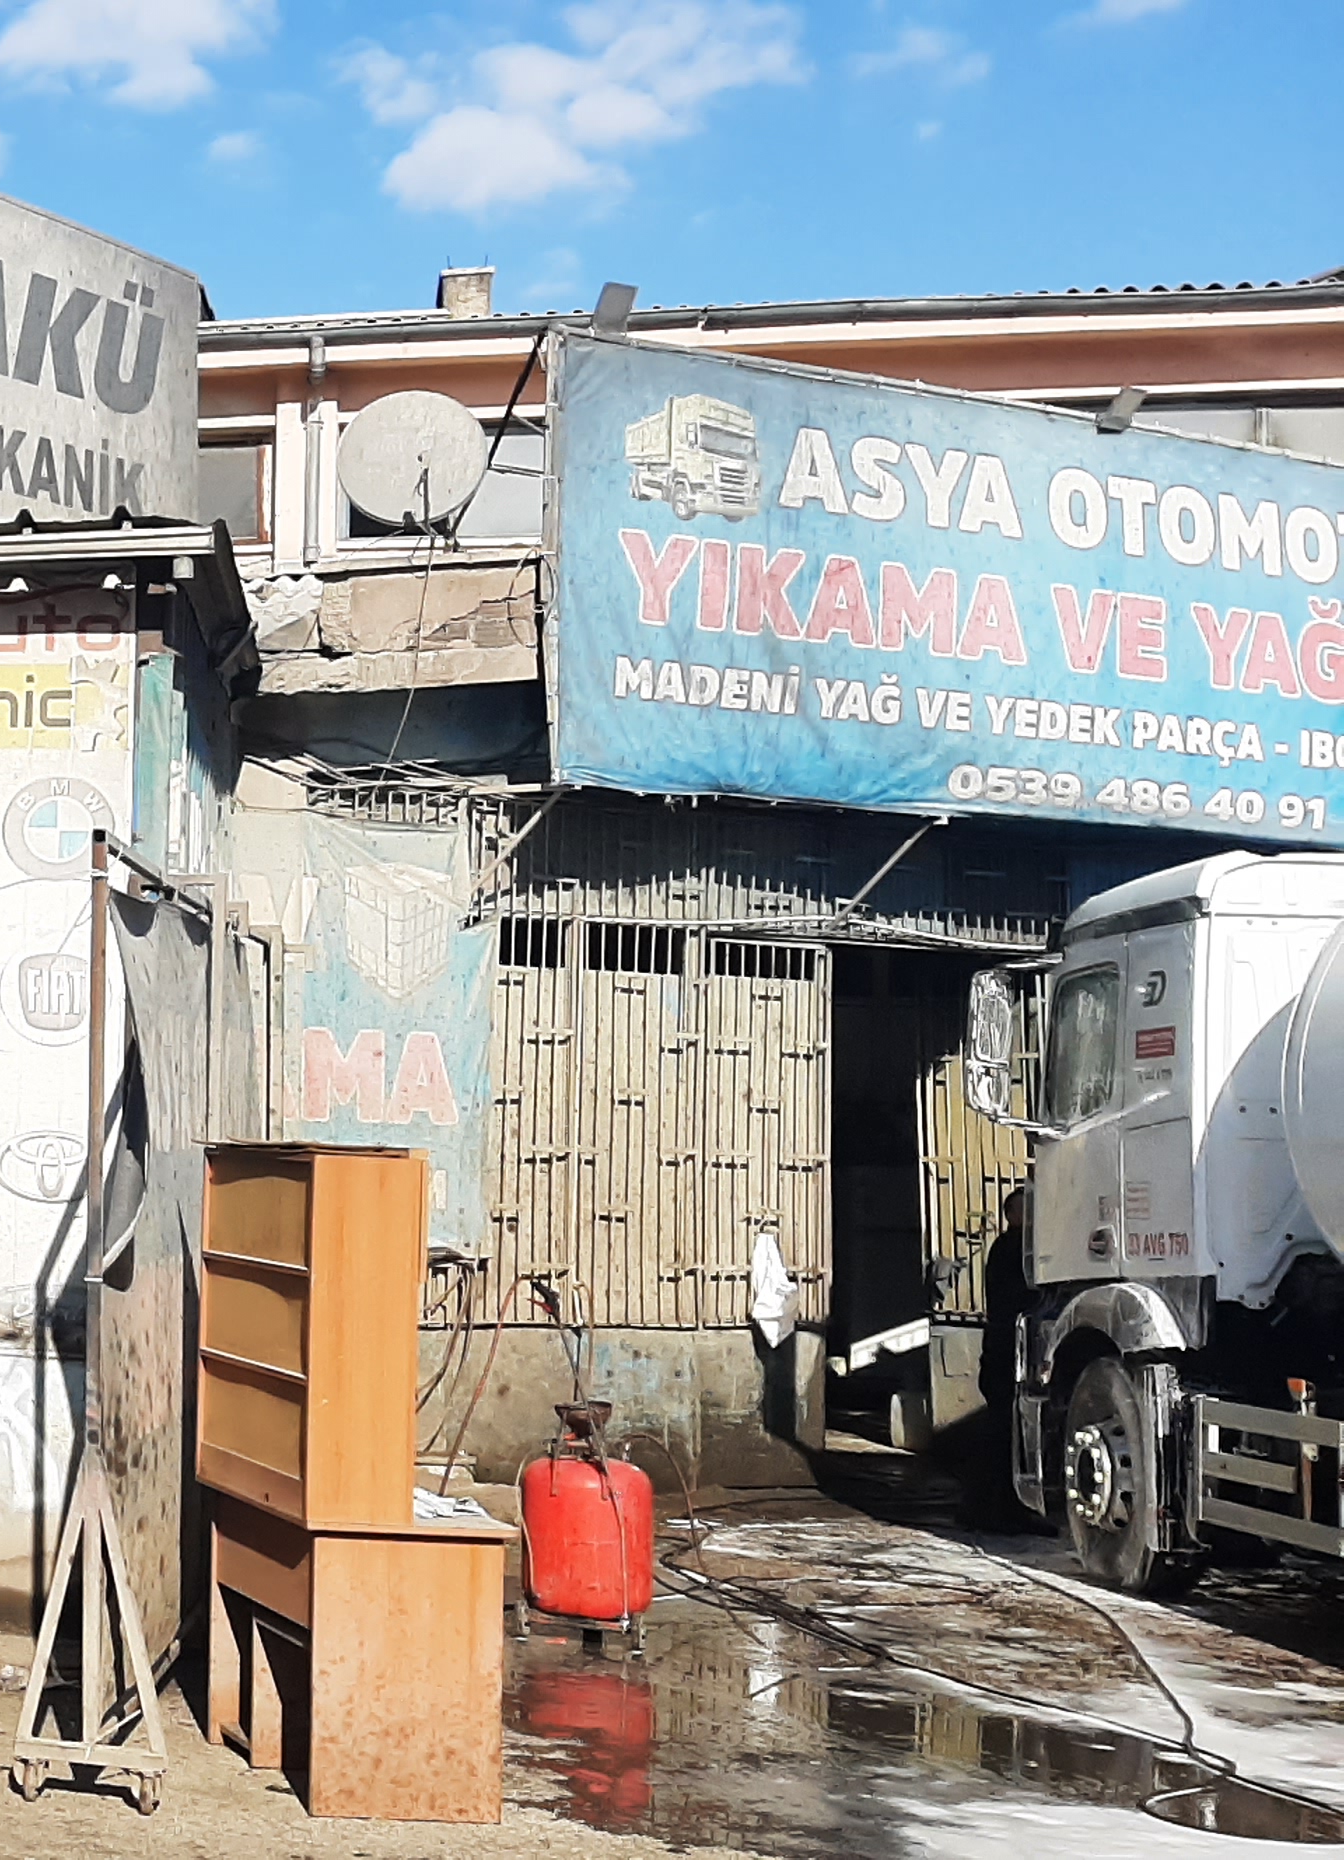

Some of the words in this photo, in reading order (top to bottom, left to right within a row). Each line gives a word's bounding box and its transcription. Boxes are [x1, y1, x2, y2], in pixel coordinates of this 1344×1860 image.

[778, 427, 1024, 539] ASYA
[1047, 468, 1344, 584] OTOMO
[618, 529, 1027, 666] YIKAMA
[1051, 582, 1168, 683] VE
[1190, 596, 1344, 704] YAĞ
[614, 655, 799, 717] MADENİ
[816, 672, 902, 727] YAĞ
[917, 687, 972, 733] VE
[985, 697, 1122, 749] YEDEK
[1132, 711, 1266, 768] PARÇA
[947, 764, 1081, 808] 0539
[1095, 776, 1192, 820] 486
[1206, 788, 1267, 825] 40
[1279, 794, 1328, 832] 91
[27, 966, 87, 1017] FIAT
